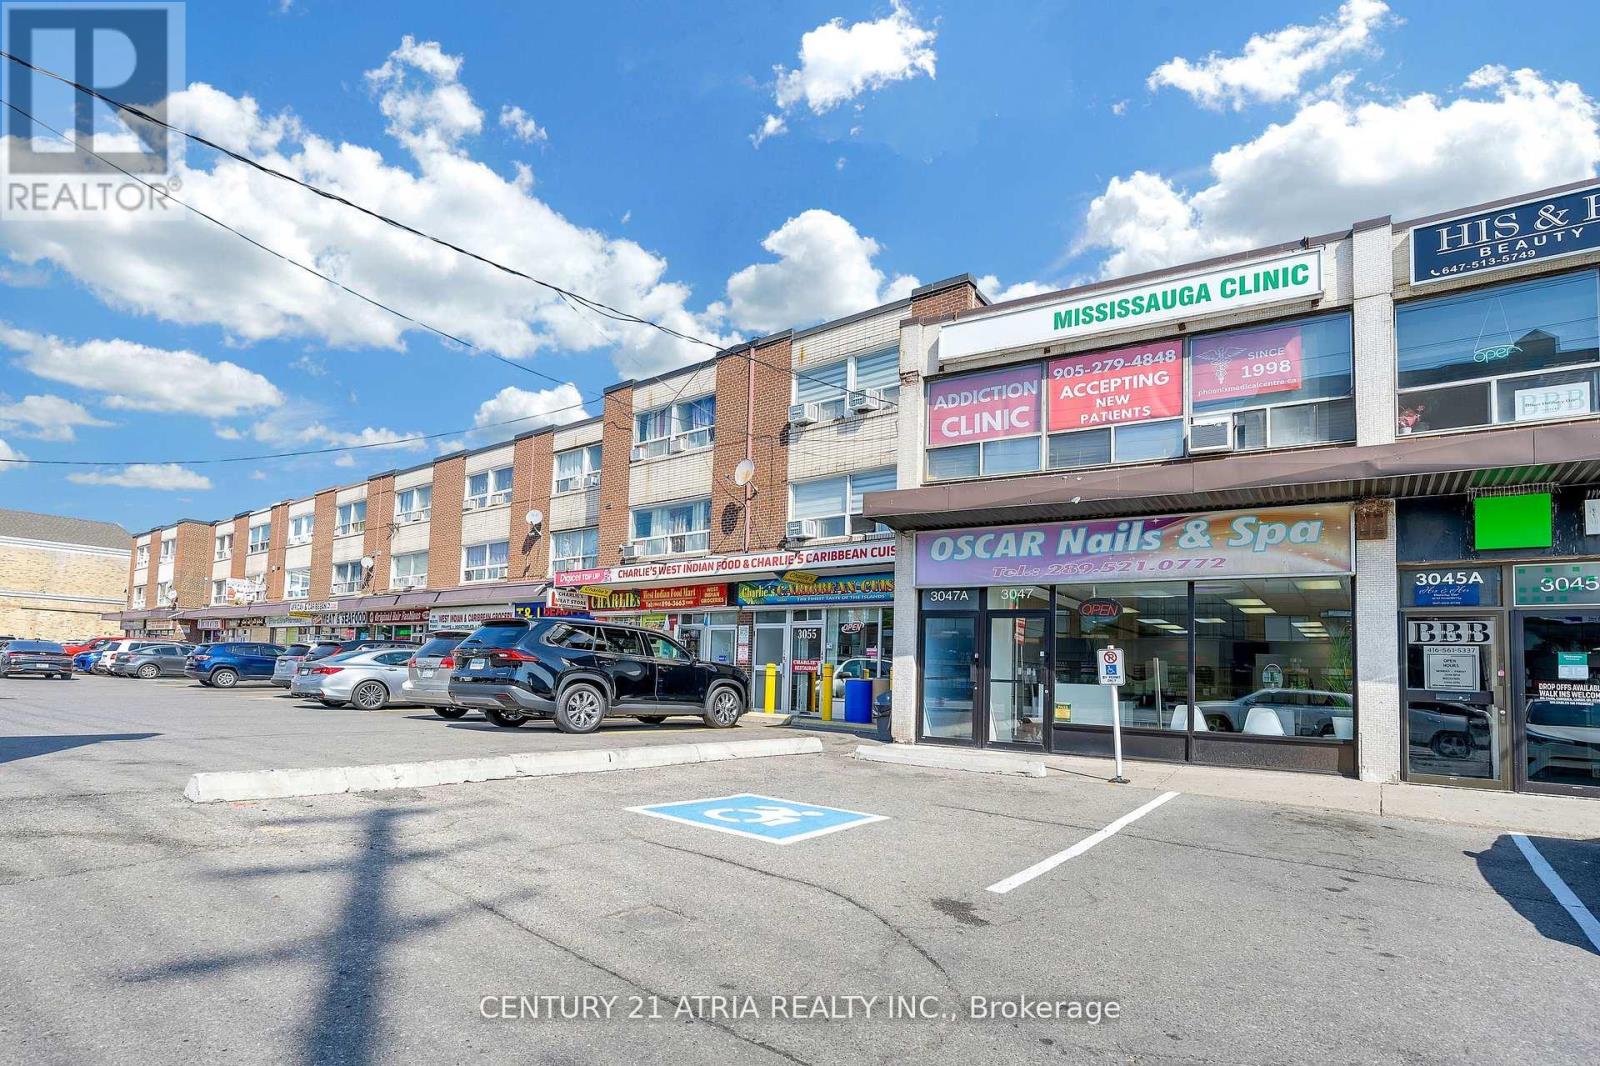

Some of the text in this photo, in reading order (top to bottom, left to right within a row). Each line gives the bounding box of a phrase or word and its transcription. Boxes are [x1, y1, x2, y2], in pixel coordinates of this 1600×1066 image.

[1437, 212, 1519, 252] HIS
[1534, 204, 1569, 231] &
[1480, 227, 1584, 258] BEAUTY
[1441, 249, 1537, 275] 647-513-5749
[1053, 263, 1310, 331] MISSISSAUGA CLINIC
[1247, 346, 1286, 360] SINCE
[1053, 348, 1177, 381] 905-279-4848
[1241, 359, 1292, 379] 1998
[1059, 370, 1170, 400] ACCEPTING
[933, 379, 1039, 411] ADDICTION
[1096, 393, 1130, 409] NEW
[941, 404, 1031, 439] CLINIC
[1079, 404, 1152, 426] PATIENTS
[929, 514, 1325, 562] OSCAR Nails & Spa
[618, 564, 657, 579] CHARLIE'S
[659, 564, 682, 576] WEST
[683, 561, 715, 574] INDIAN
[716, 559, 741, 571] FOOD
[742, 558, 750, 569] &
[751, 555, 804, 568] CHARLIE'S
[806, 547, 868, 564] CARIBBEAN
[1047, 557, 1227, 577] 289.521.0772
[593, 572, 600, 580] UP
[1416, 571, 1484, 586] 3045A
[1540, 575, 1600, 592] 3045
[655, 589, 670, 599] Indian
[671, 588, 682, 598] Food
[683, 587, 696, 597] Mart
[742, 584, 775, 598] Charlie's
[930, 590, 969, 602] 3047A
[1001, 588, 1034, 600] 3047
[341, 611, 367, 625] SEAFOOD
[1081, 603, 1119, 616] OPEN
[797, 628, 818, 640] 3055
[843, 622, 862, 632] OPEN
[1413, 622, 1491, 643] BBB
[1538, 682, 1556, 691] DROP
[1556, 683, 1572, 692] OFFS
[1539, 690, 1559, 698] WALK
[1559, 690, 1571, 698] INS
